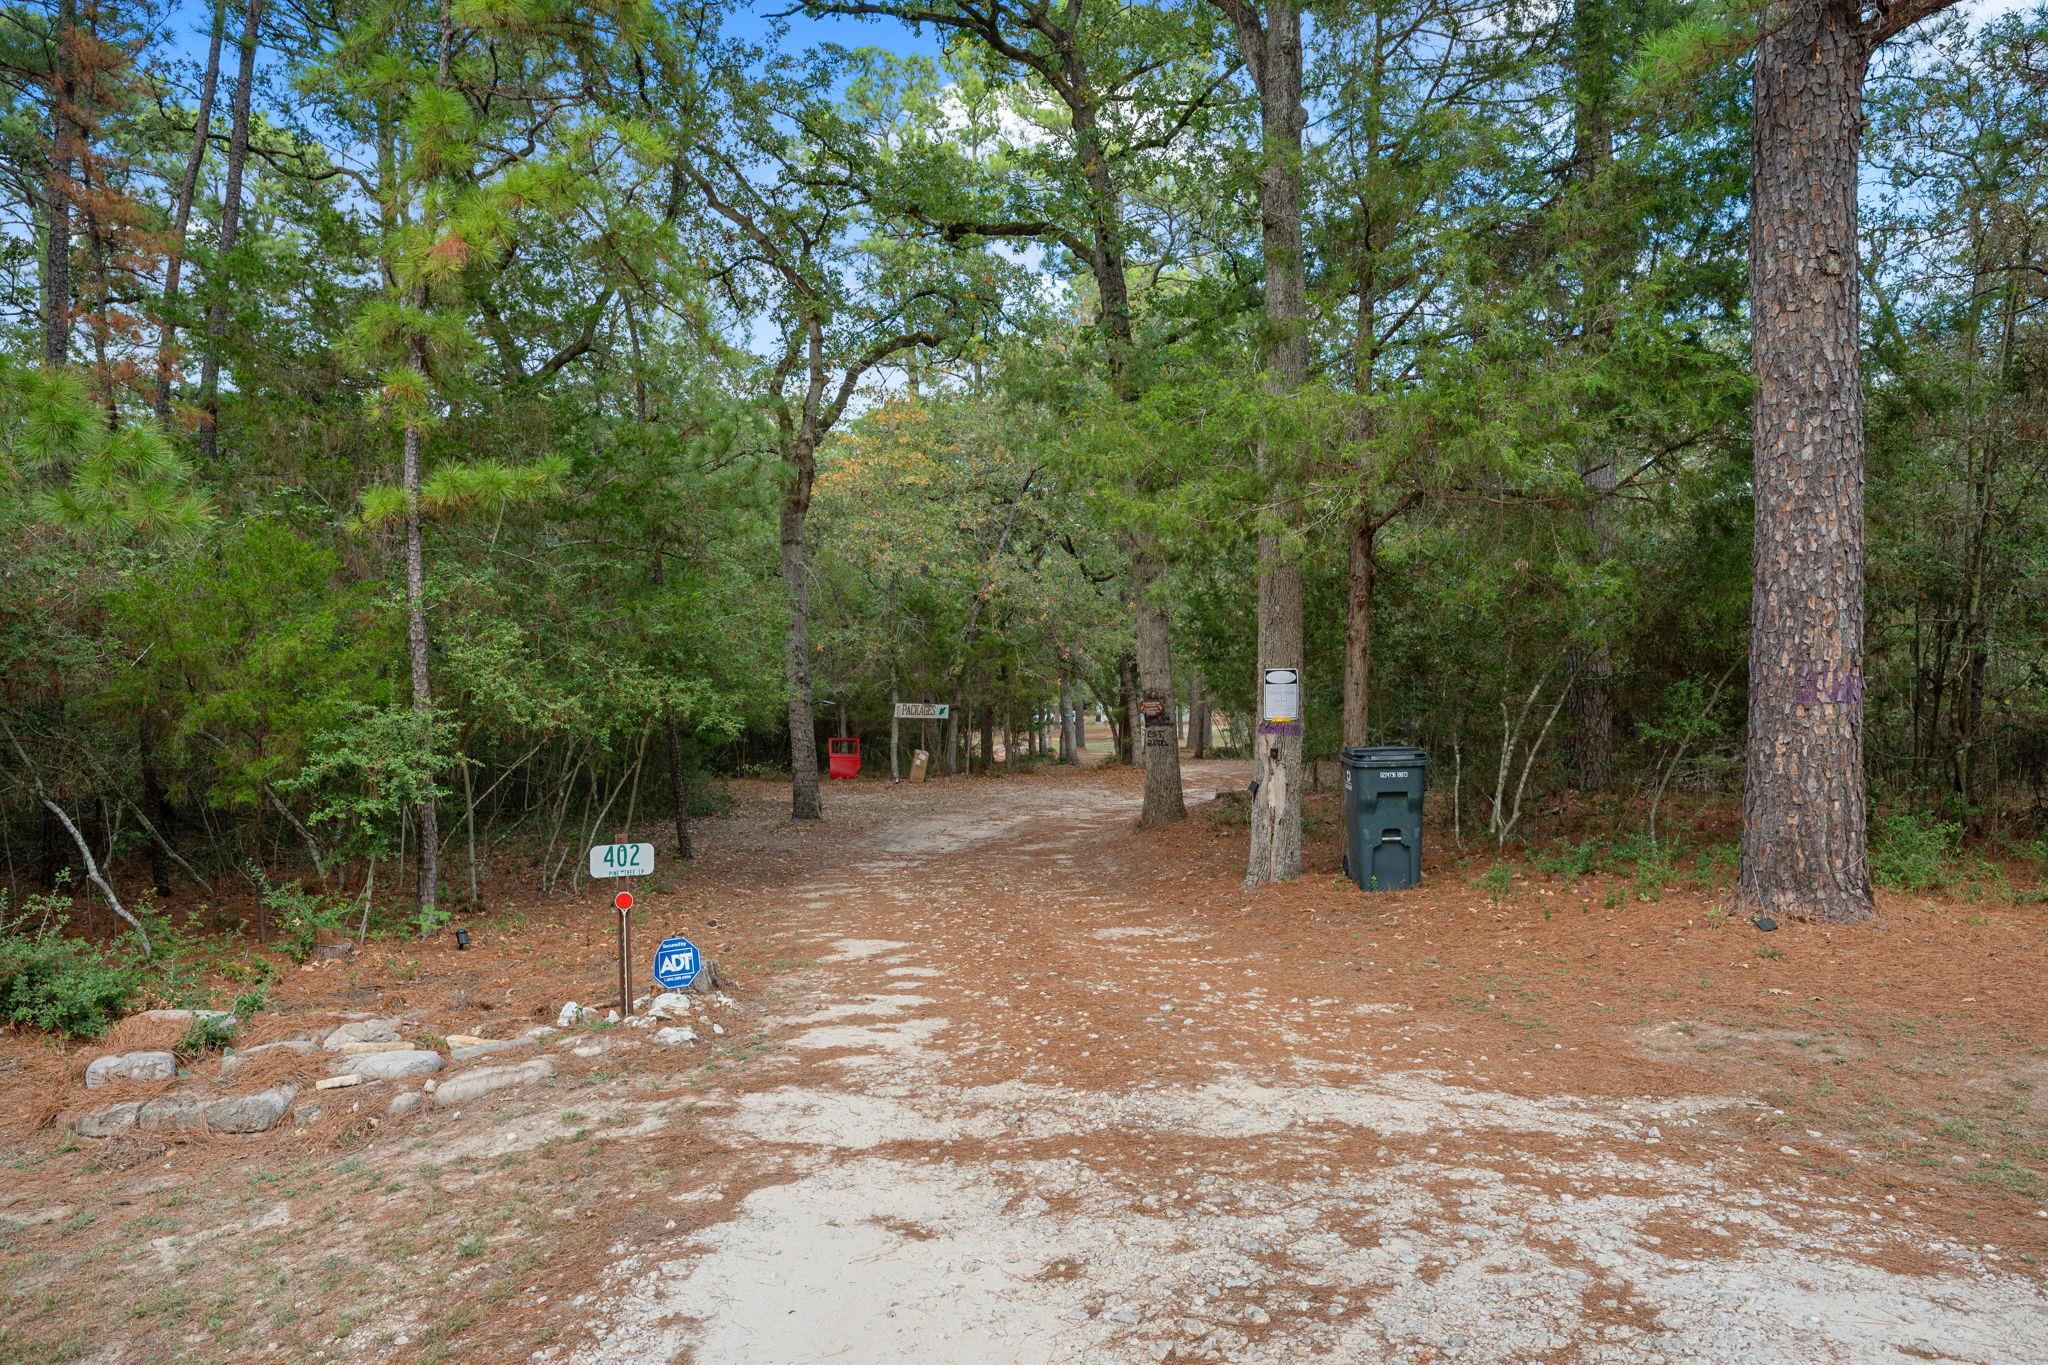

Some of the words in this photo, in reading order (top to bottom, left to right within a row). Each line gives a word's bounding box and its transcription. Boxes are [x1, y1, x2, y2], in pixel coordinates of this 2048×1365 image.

[902, 704, 935, 715] PACKAGES
[603, 844, 640, 867] 402
[660, 952, 693, 974] ADT
